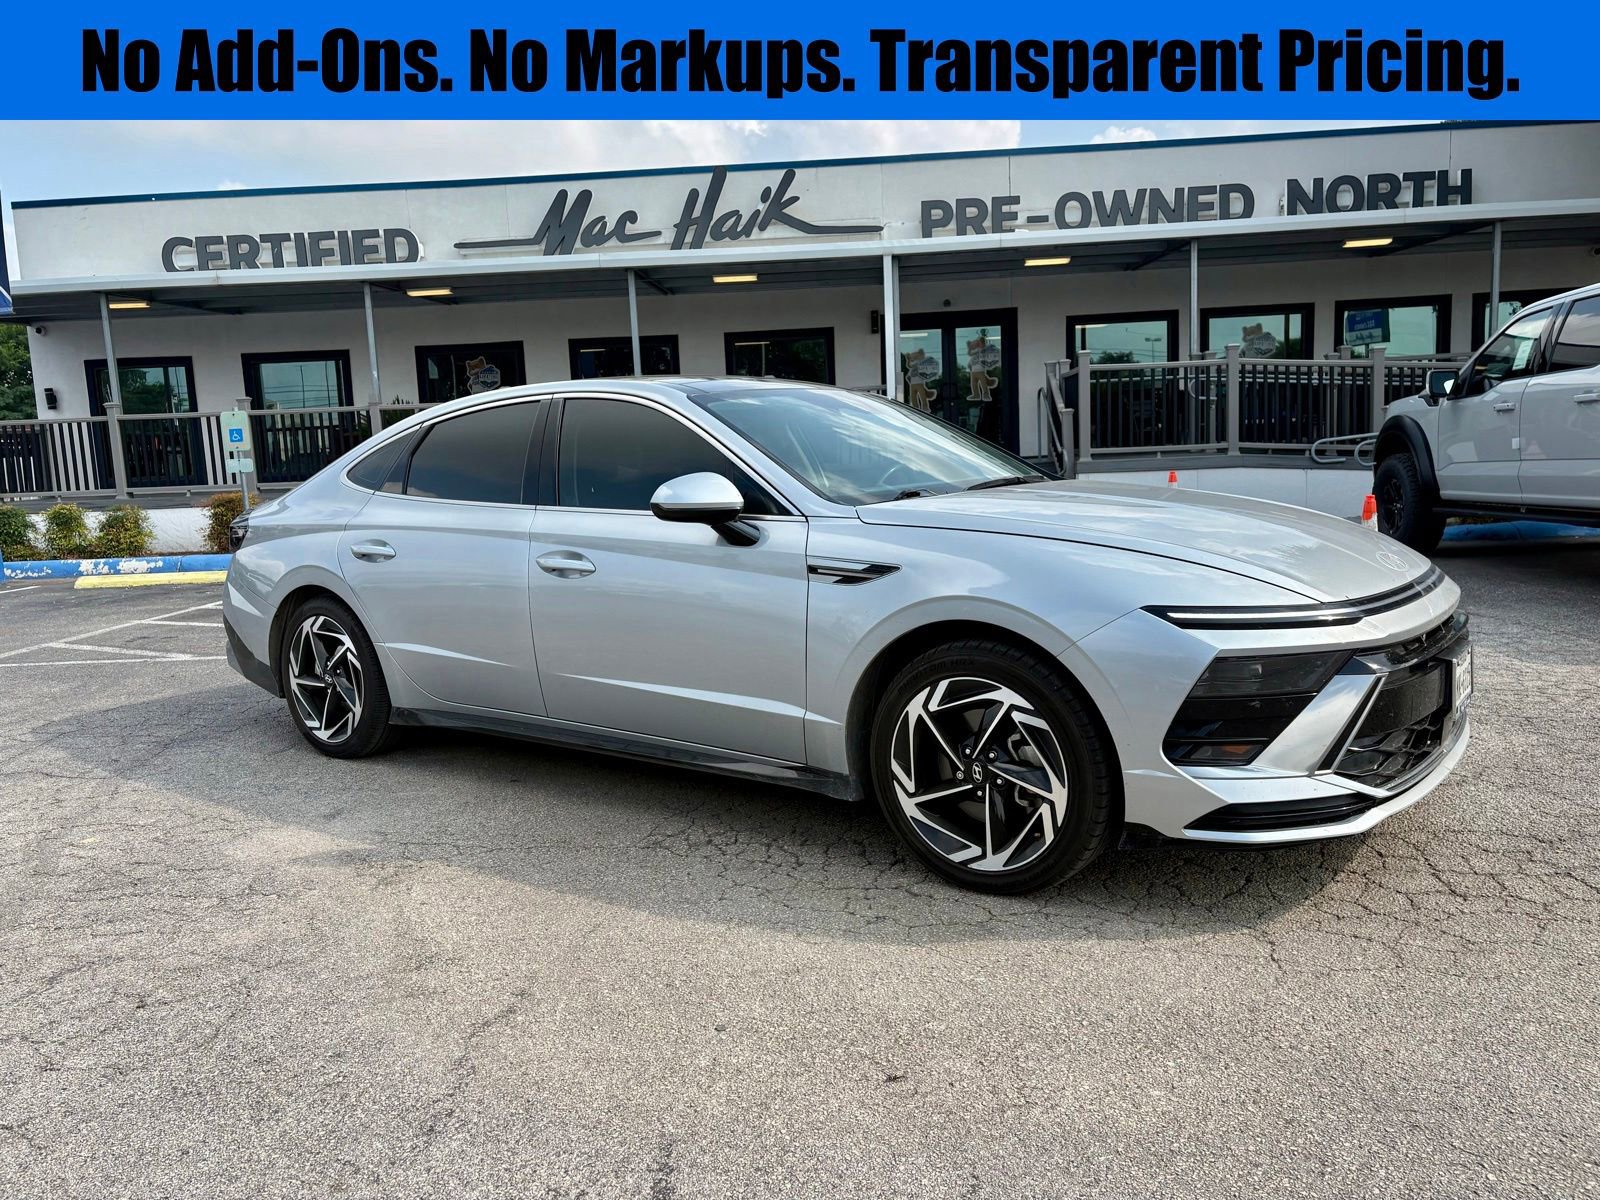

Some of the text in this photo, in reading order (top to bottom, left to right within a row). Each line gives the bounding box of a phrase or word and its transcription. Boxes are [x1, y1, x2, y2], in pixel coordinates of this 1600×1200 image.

[454, 166, 884, 255] Mac Haik
[920, 168, 1472, 238] PRE-OWNED NORTH
[161, 228, 419, 272] CERTIFIED
